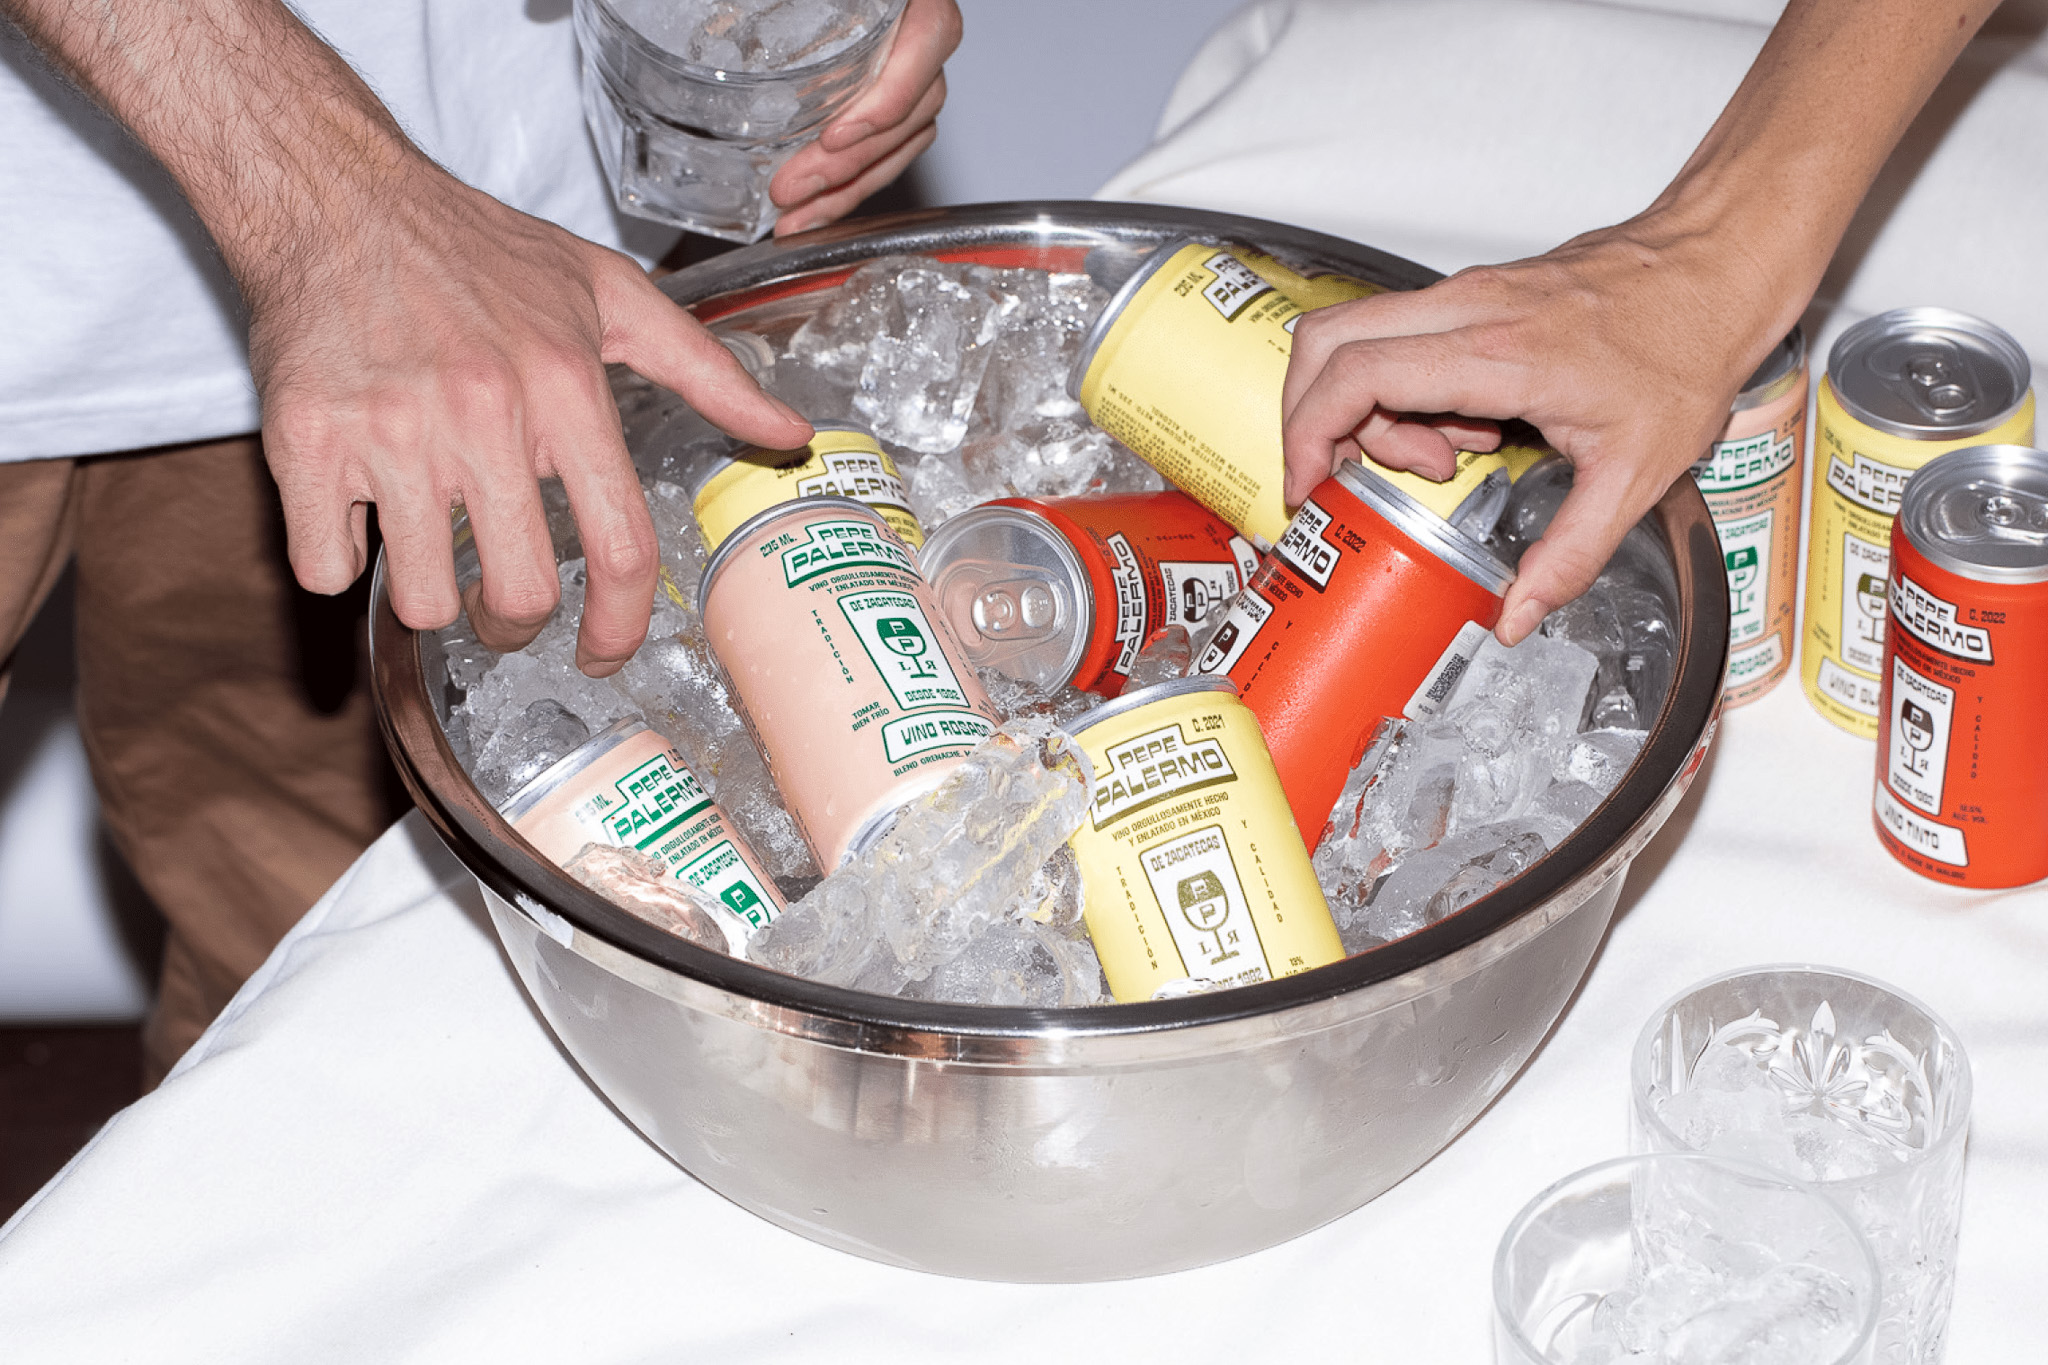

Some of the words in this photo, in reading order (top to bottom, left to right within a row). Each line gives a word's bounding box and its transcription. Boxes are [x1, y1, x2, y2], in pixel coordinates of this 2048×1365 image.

[1721, 440, 1769, 460] PEPE
[832, 459, 880, 473] PEPE
[1833, 465, 1901, 504] PALER
[818, 527, 875, 541] PEPE
[792, 541, 911, 573] PALERMO
[808, 577, 829, 592] VINO
[830, 571, 898, 585] ORGULLOSAMENTE
[826, 586, 833, 594] Y
[835, 579, 875, 592] ENLATADO
[877, 577, 887, 587] EN
[1164, 568, 1177, 622] ZACATECAS
[849, 599, 865, 612] DE
[865, 596, 916, 610] ZACATECAS
[1114, 541, 1142, 668] PALERMO
[1118, 576, 1130, 635] PEPE
[1906, 585, 1948, 620] PEPE
[889, 620, 906, 634] P
[1285, 620, 1293, 630] Y
[1891, 584, 1983, 652] PALERMO
[811, 609, 854, 684] TRADICIÓN
[898, 638, 915, 651] P
[904, 688, 937, 702] DESDE
[851, 716, 869, 732] BIEN
[871, 707, 890, 721] FRÍO
[852, 701, 880, 720] TOMAR
[1191, 718, 1204, 732] C.
[1202, 714, 1226, 731] 2021
[900, 721, 938, 746] VINO
[1971, 715, 1982, 779] CALIDAD
[1118, 735, 1177, 769] PEPE
[628, 764, 673, 799] PEPE
[893, 760, 918, 777] BLEND
[1096, 749, 1223, 812] PALERMO
[613, 775, 703, 844] PALERMO
[1111, 826, 1130, 841] VINO
[1131, 801, 1203, 832] ORGULLOSAMENTE
[1205, 791, 1229, 806] HECHO
[1240, 819, 1247, 829] Y
[660, 818, 711, 855] ORGULLOSAMENTE
[1128, 836, 1134, 846] Y
[1136, 821, 1176, 844] ENLATADO
[1178, 815, 1189, 827] EN
[1191, 806, 1221, 822] MÉXICO
[1907, 820, 1938, 849] TINTO
[668, 835, 701, 865] ENLATADO
[698, 831, 709, 845] EN
[1150, 856, 1165, 872] DE
[1166, 835, 1221, 867] ZACATECAS
[1250, 843, 1283, 923] CALIDAD
[730, 888, 745, 908] P
[746, 909, 762, 929] P
[1116, 866, 1158, 970] TRADICIÓN
[1199, 903, 1215, 925] P
[1198, 941, 1211, 955] L
